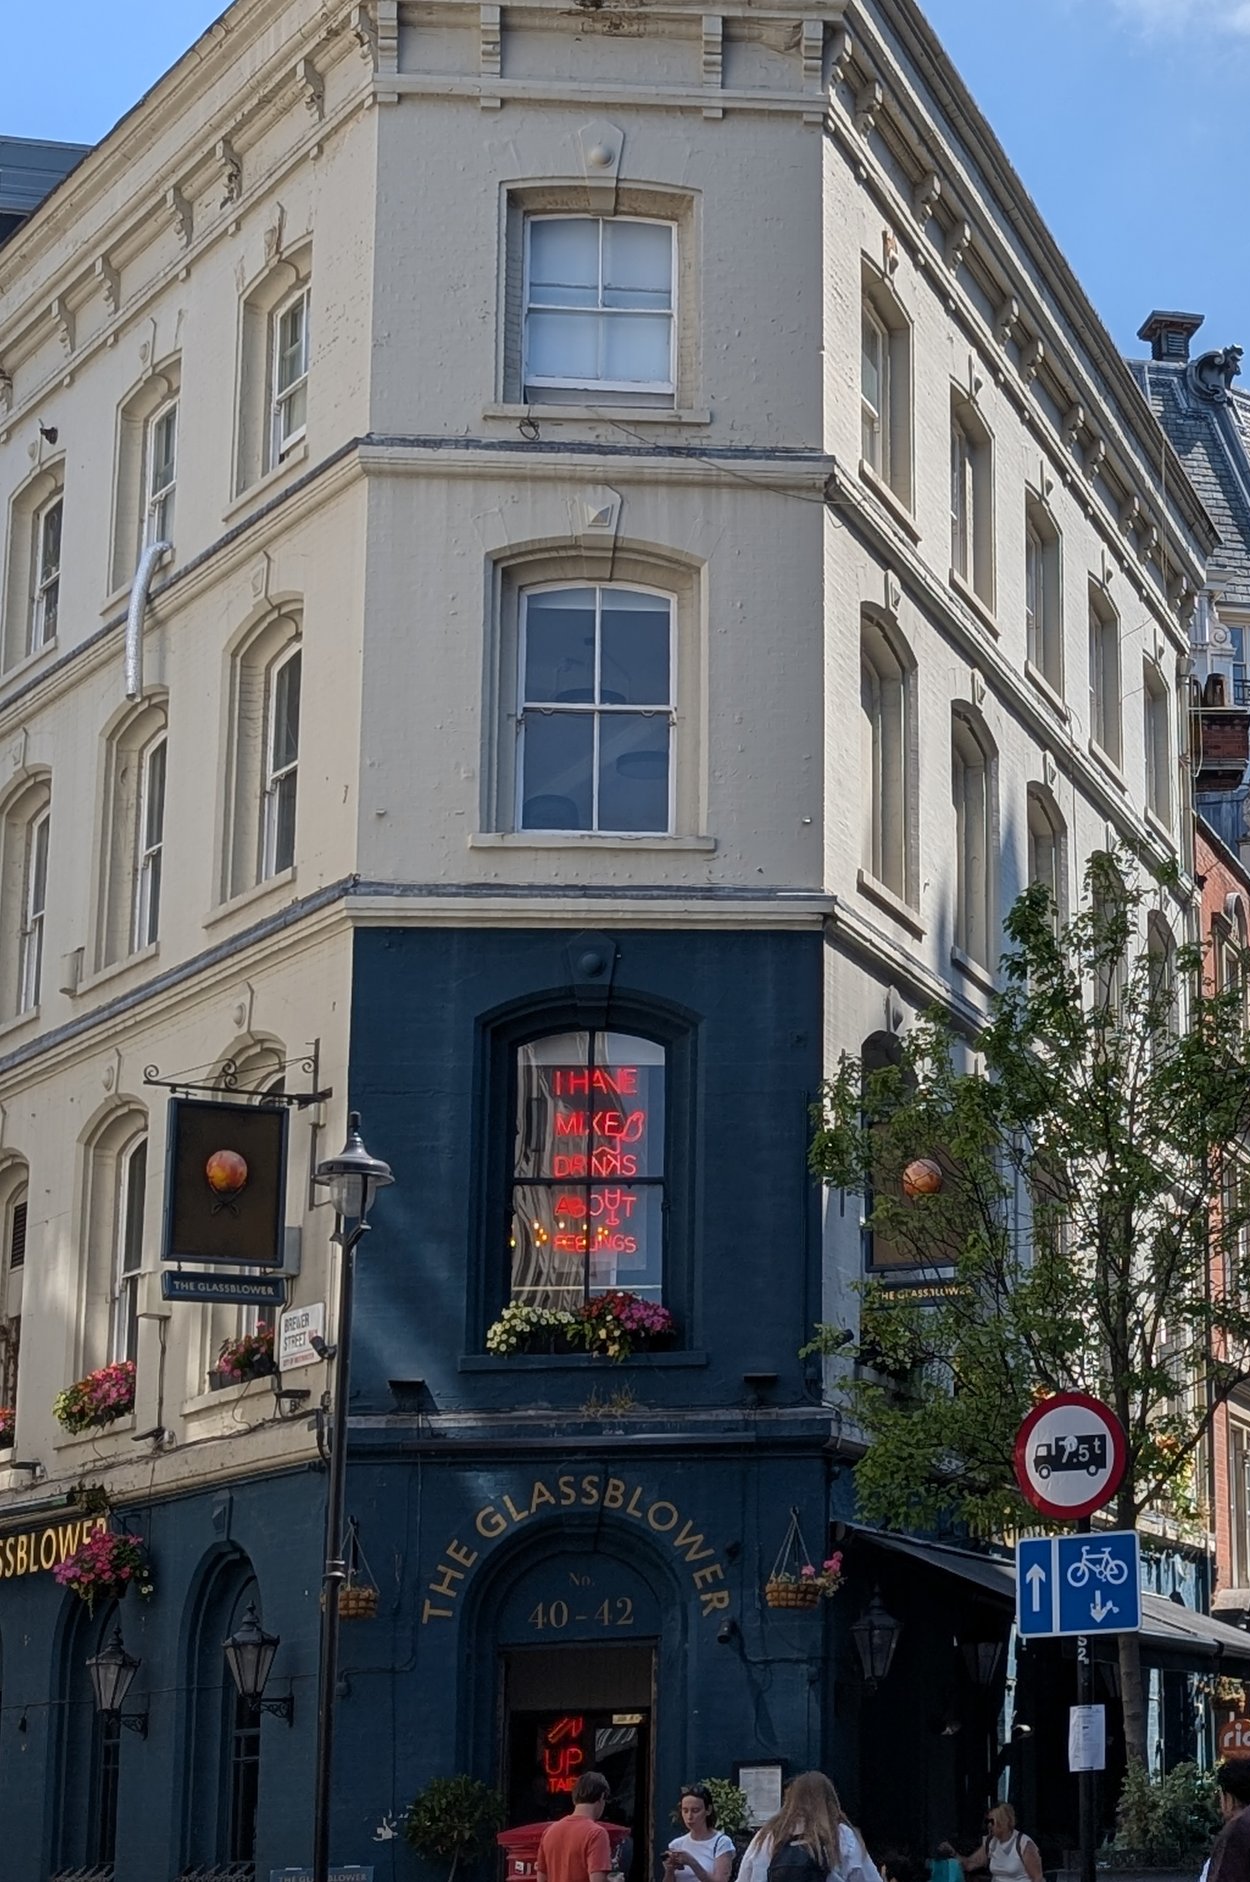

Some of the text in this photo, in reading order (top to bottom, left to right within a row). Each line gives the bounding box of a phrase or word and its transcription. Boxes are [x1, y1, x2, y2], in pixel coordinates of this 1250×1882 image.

[556, 1070, 561, 1096] I
[554, 1154, 637, 1178] DRNKS
[555, 1190, 637, 1224] ABOUT
[173, 1280, 275, 1296] THE GLASSBLOWER
[284, 1312, 310, 1333] BREWER
[283, 1331, 307, 1351] STREET
[0, 1517, 107, 1578] SBLOWE
[421, 1474, 730, 1625] THE GLASSBLOWER
[568, 1572, 596, 1588] No.
[544, 1746, 583, 1775] UP
